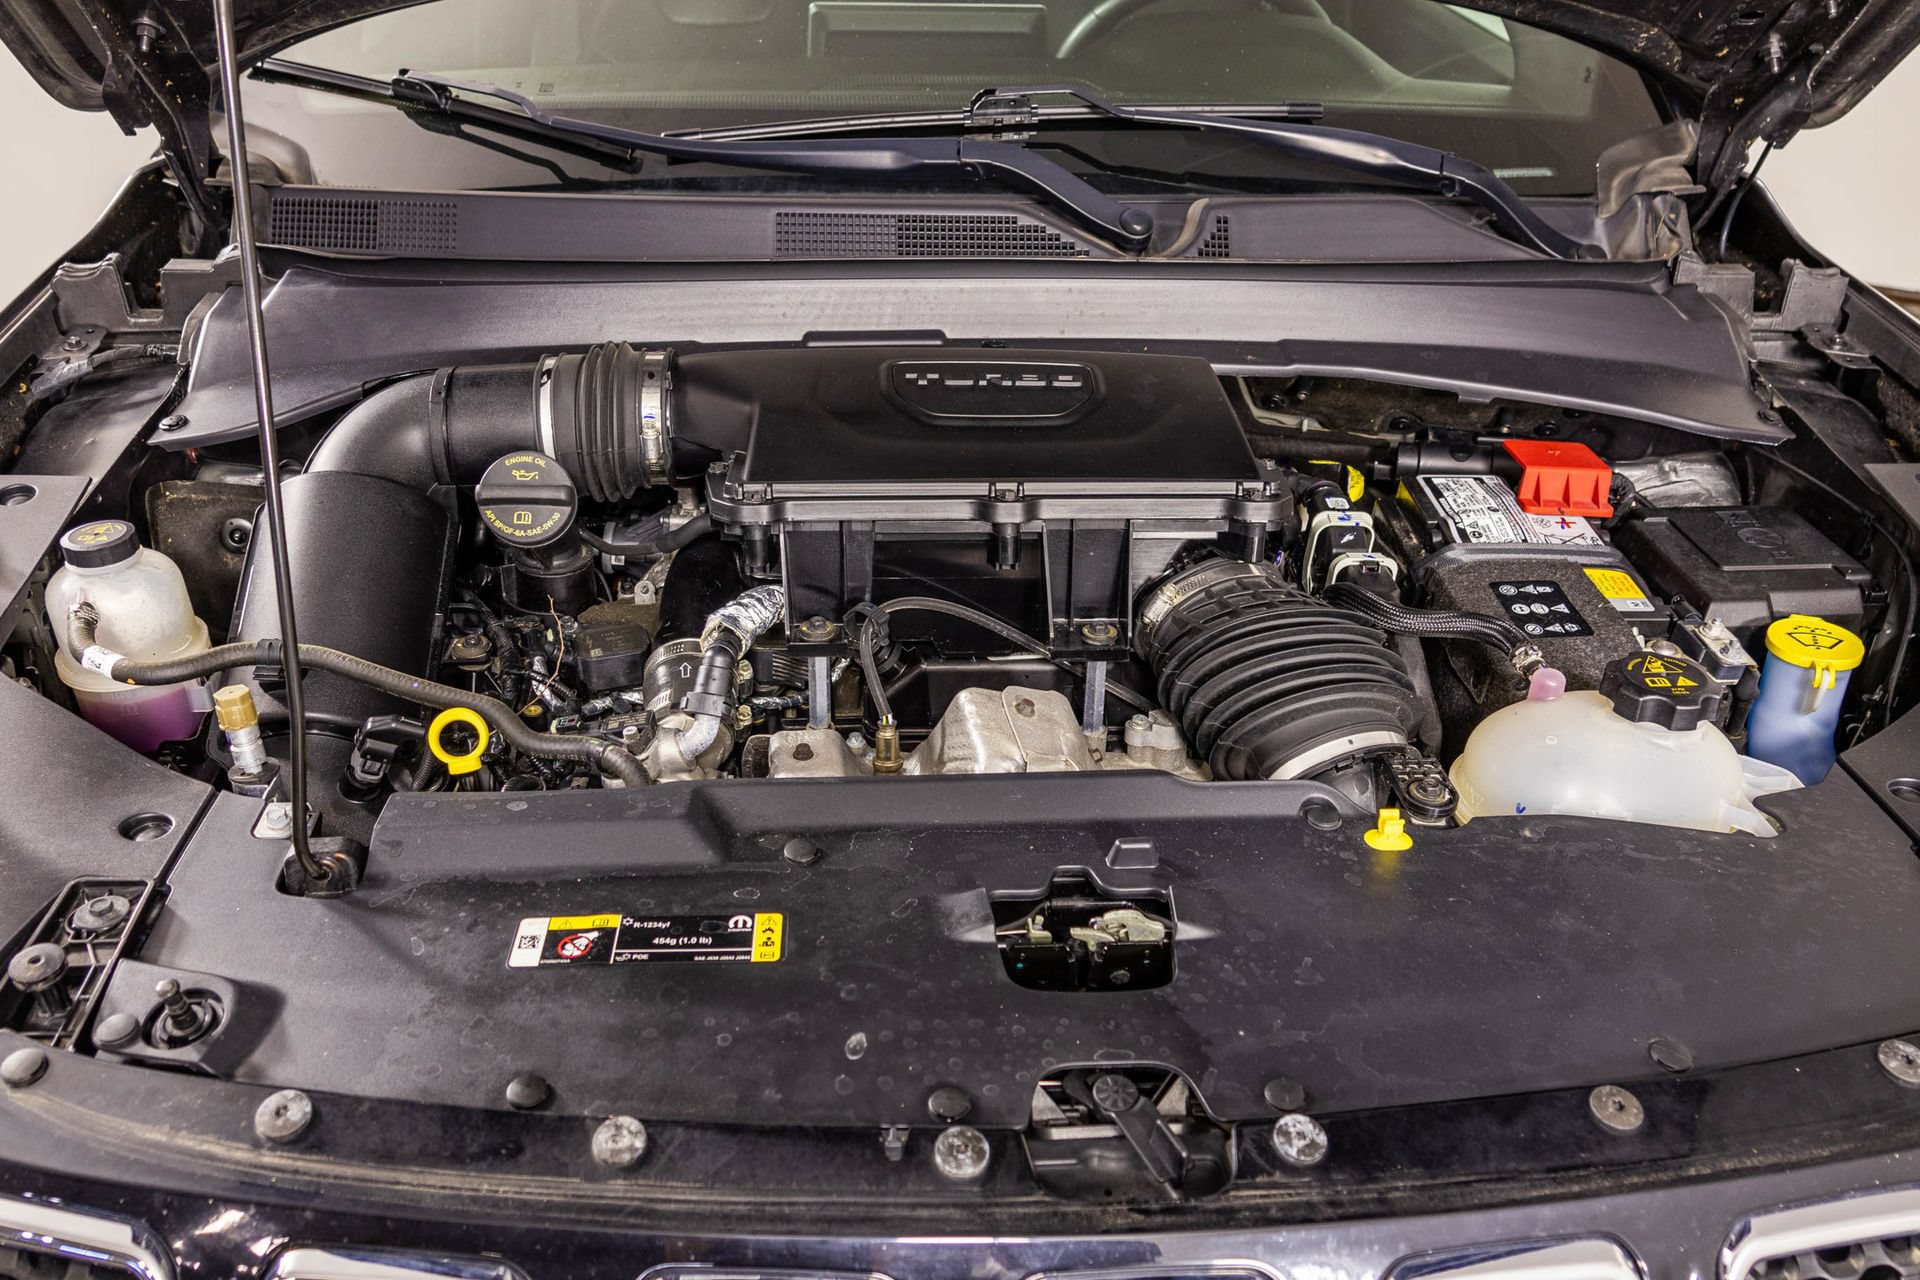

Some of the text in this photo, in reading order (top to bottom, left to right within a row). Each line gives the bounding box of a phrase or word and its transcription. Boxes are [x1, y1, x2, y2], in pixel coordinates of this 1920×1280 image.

[504, 455, 546, 468] ENGINE OIL
[485, 509, 495, 522] API
[633, 921, 671, 929] R-1234yf
[652, 936, 713, 946] 454g (1.0 lb)
